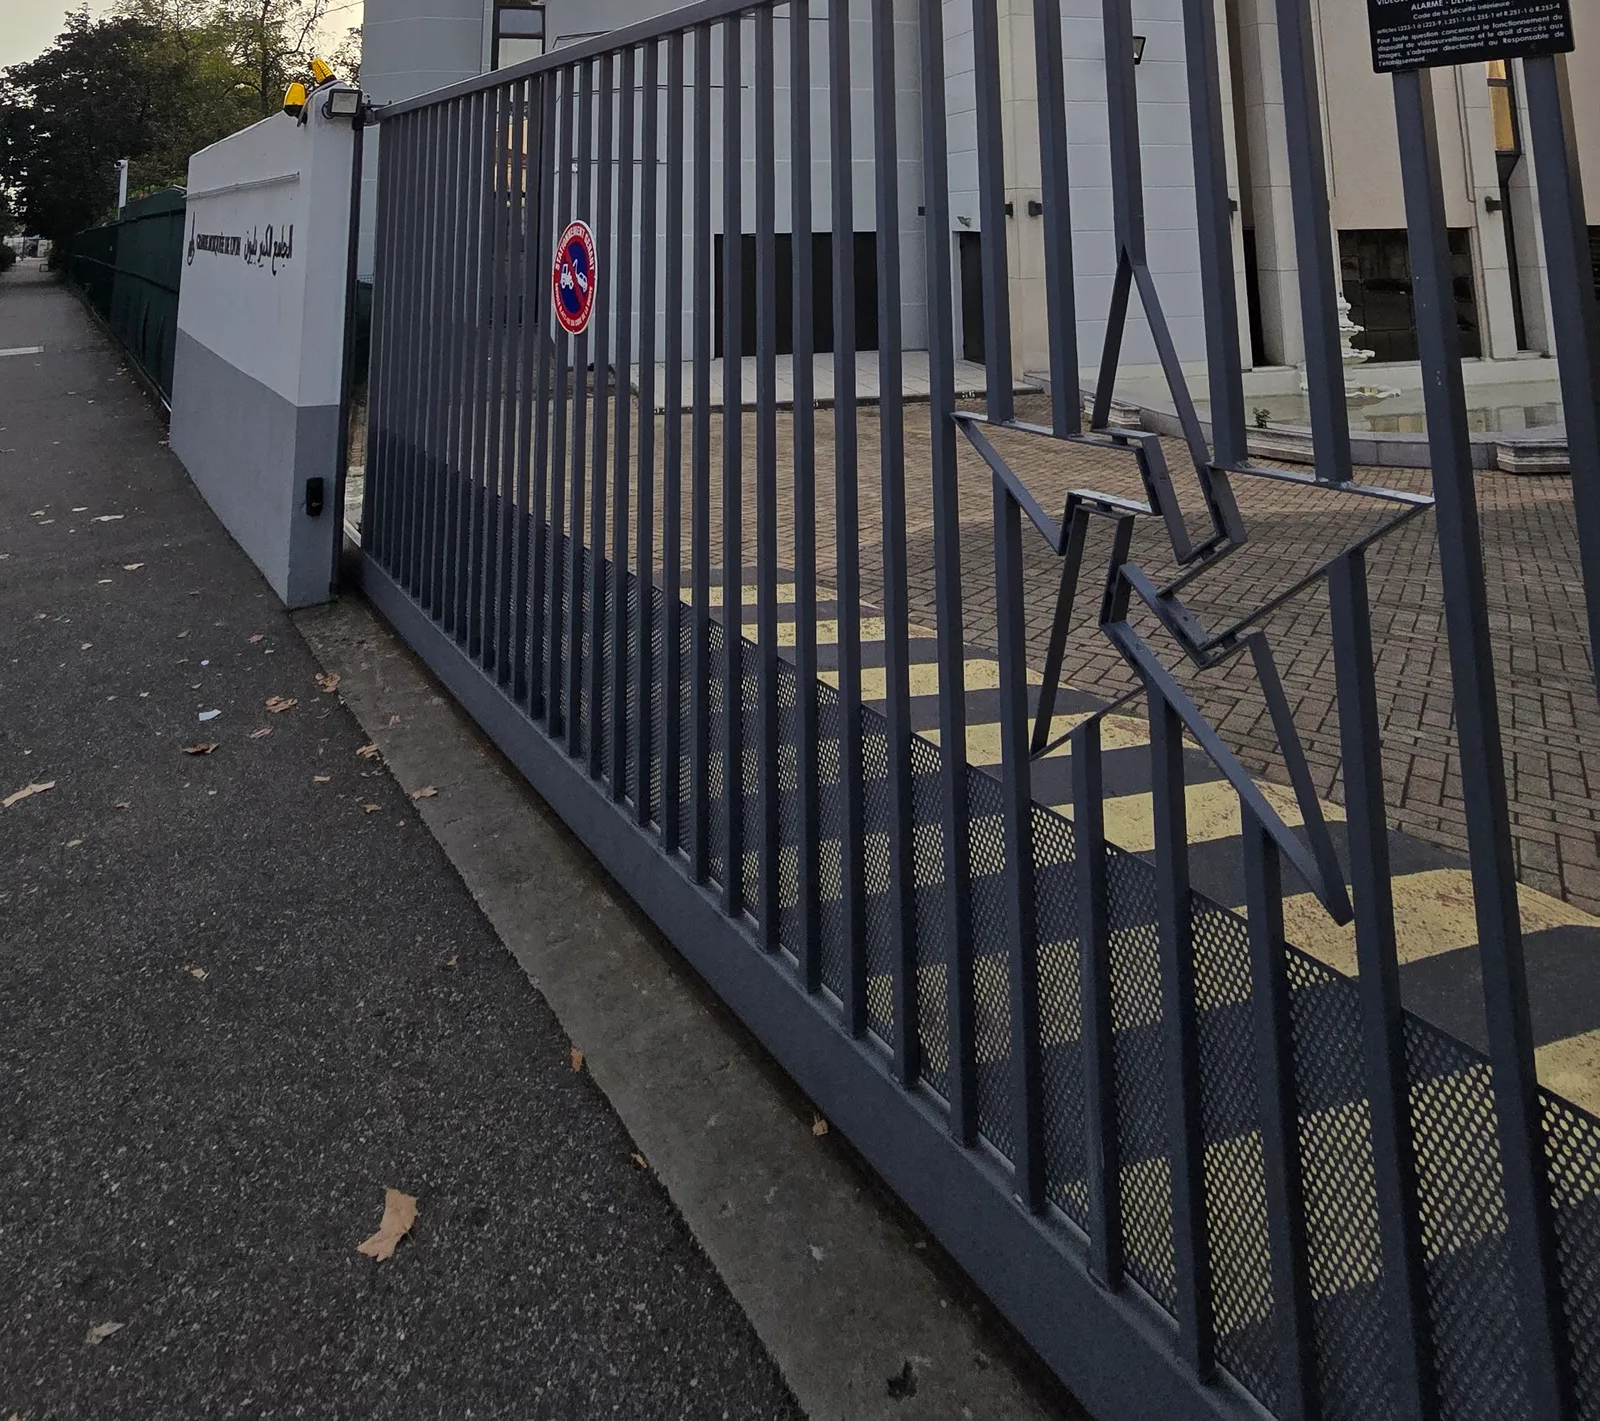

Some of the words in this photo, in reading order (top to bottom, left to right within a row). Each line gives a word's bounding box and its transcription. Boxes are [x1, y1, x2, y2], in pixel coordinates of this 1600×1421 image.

[1411, 0, 1443, 11] ALARME
[1413, 11, 1430, 19] Code
[1411, 30, 1438, 40] question
[1441, 25, 1480, 35] concernant
[1492, 15, 1549, 28] fonctionnement
[1502, 32, 1549, 44] Responsable
